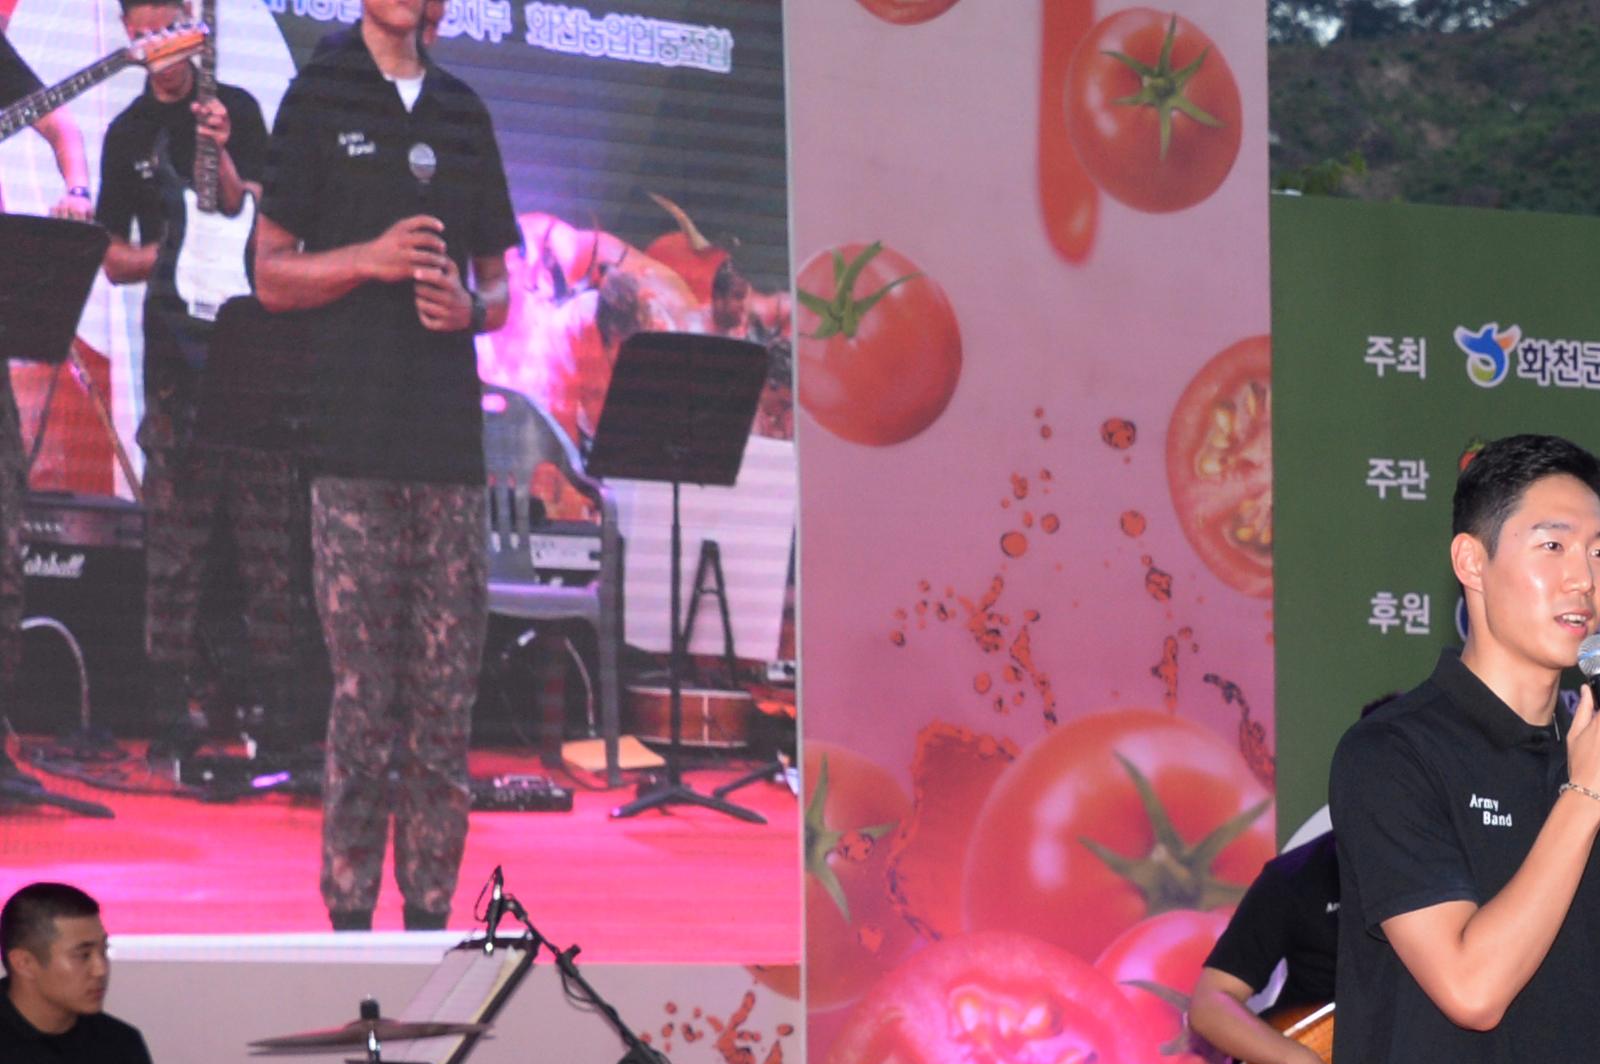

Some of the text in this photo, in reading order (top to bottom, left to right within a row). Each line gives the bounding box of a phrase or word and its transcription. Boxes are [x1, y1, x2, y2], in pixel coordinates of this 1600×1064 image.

[1364, 336, 1426, 378] 주최
[1366, 458, 1430, 500] 주관
[1368, 592, 1431, 634] 후원
[1469, 793, 1499, 812] Army
[1483, 810, 1513, 827] Band
